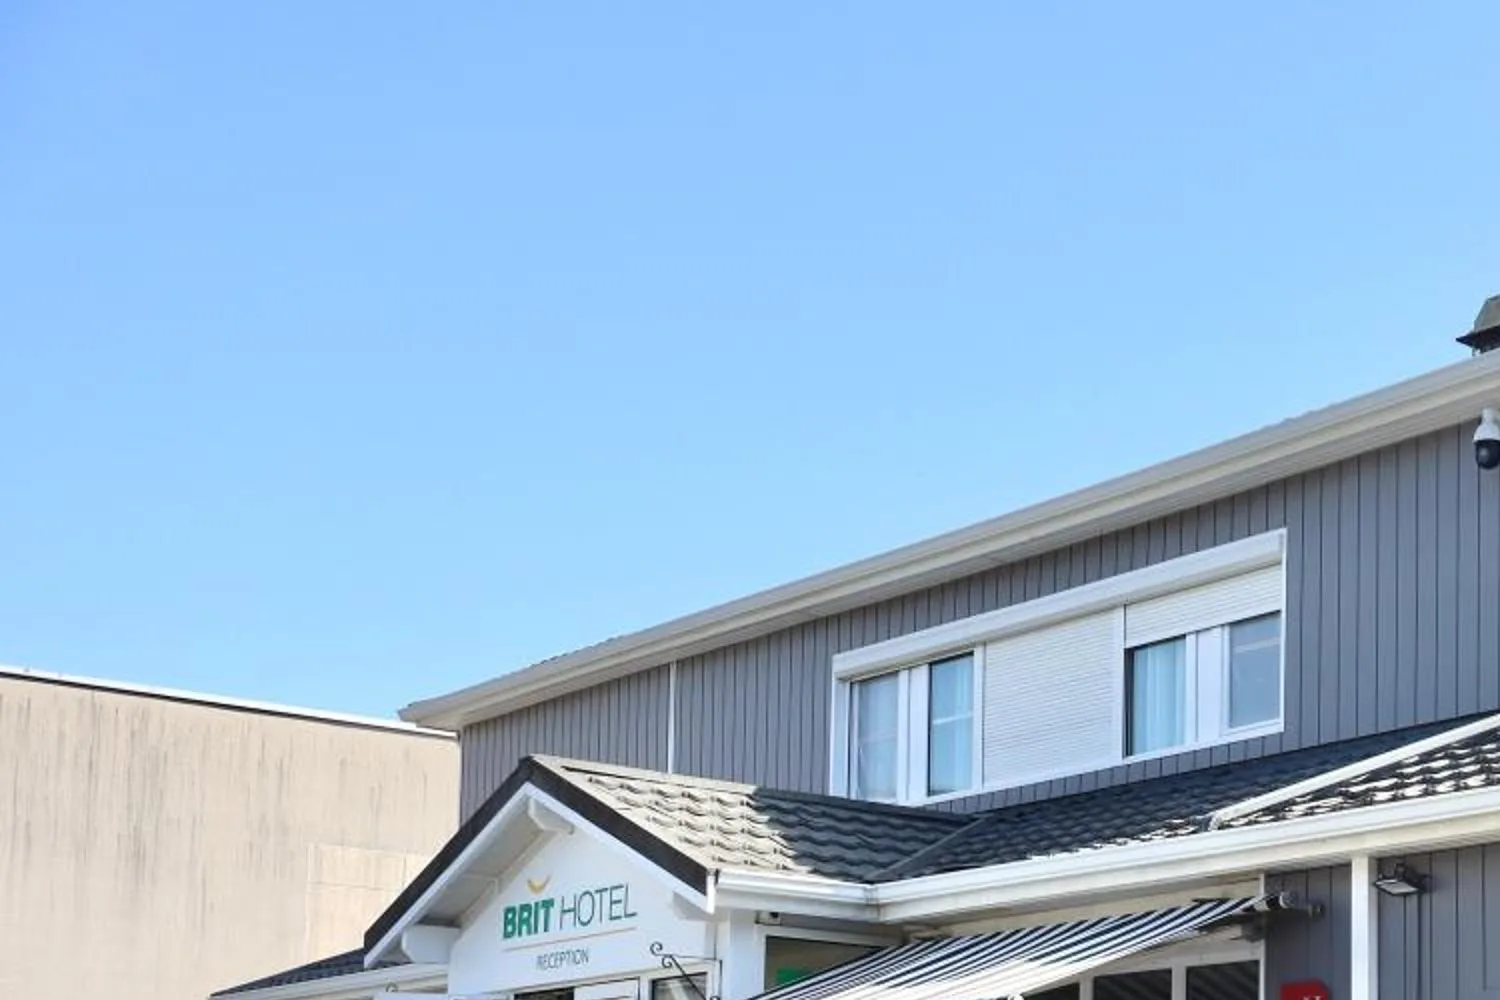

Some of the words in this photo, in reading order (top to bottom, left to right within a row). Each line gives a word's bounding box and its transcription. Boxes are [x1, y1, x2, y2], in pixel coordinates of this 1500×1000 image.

[503, 898, 555, 939] BRIT
[559, 882, 638, 930] HOTEL
[536, 949, 589, 970] RECEPTION
